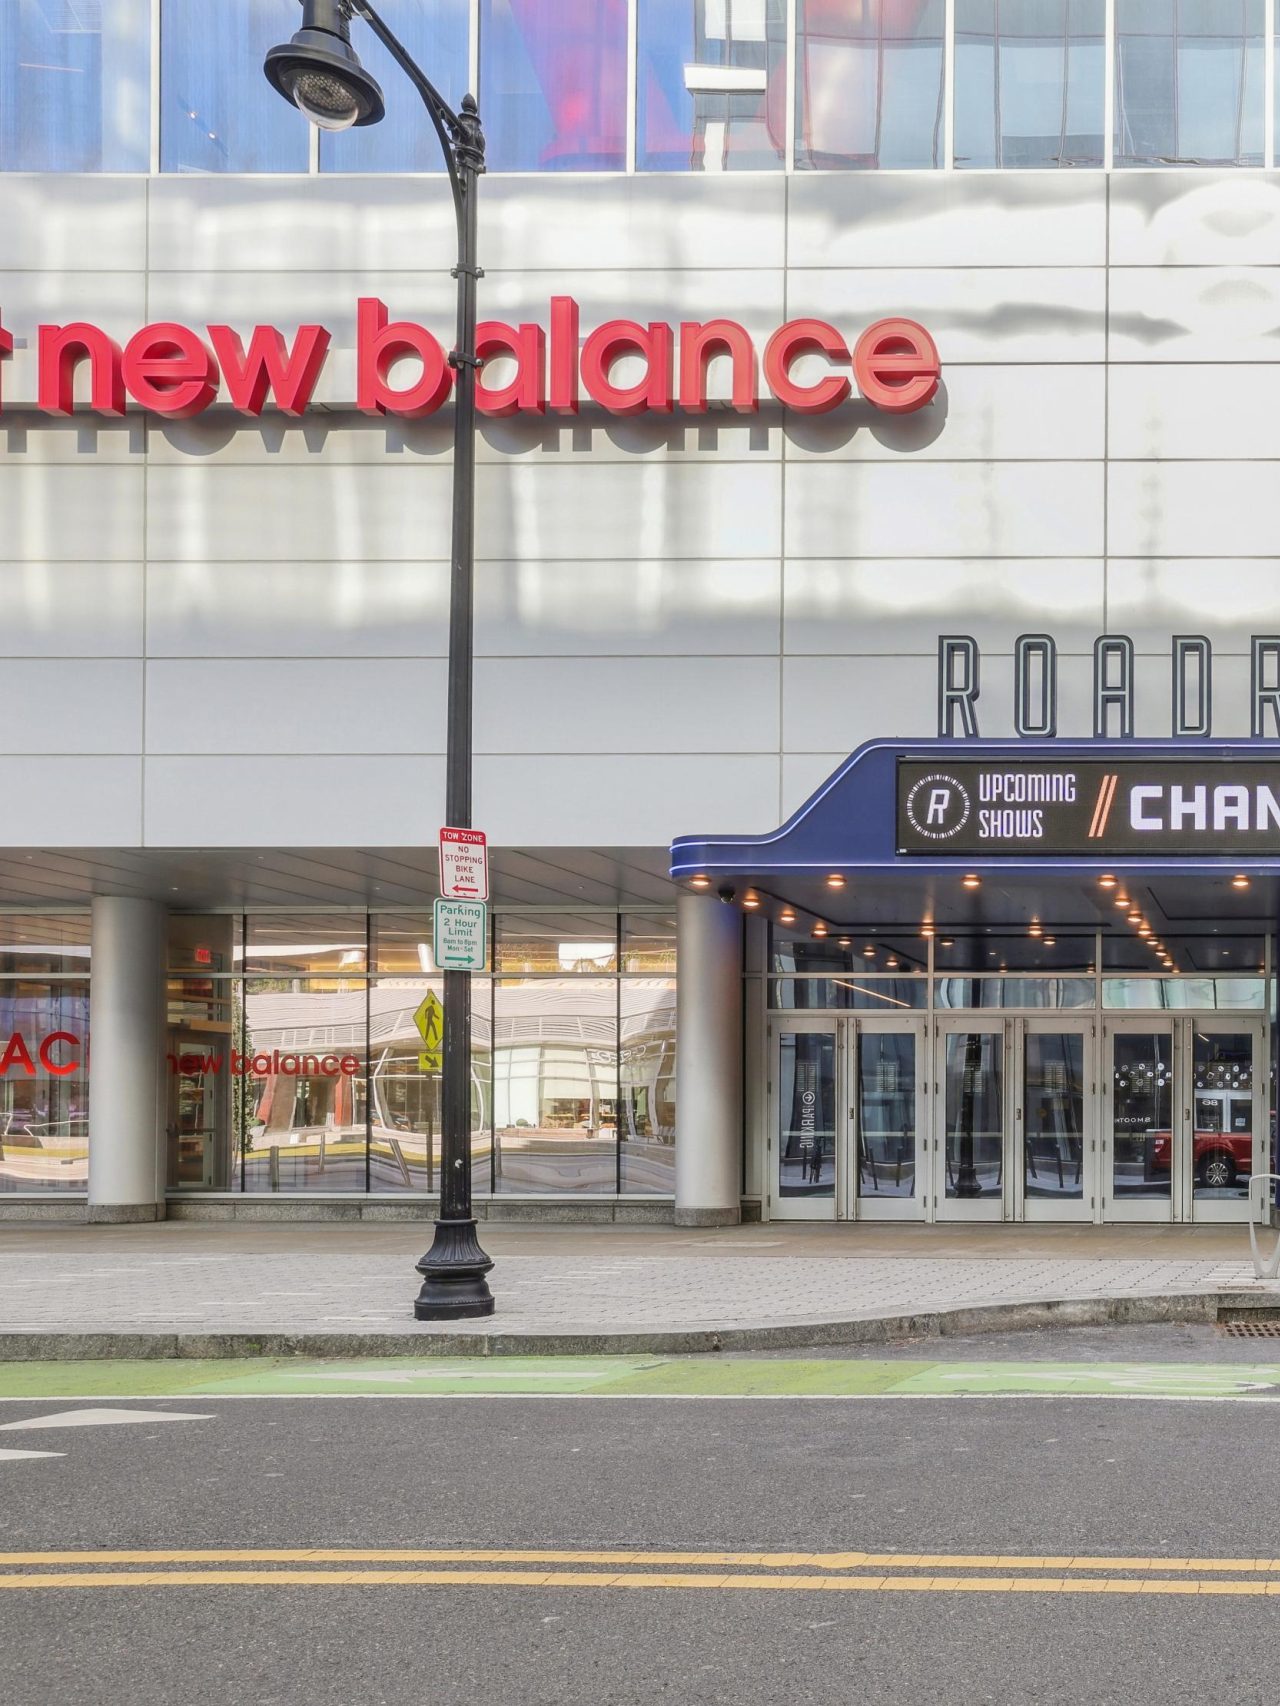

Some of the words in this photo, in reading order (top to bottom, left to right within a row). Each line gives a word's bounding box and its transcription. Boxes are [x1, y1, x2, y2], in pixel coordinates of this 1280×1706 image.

[37, 321, 331, 418] new
[357, 296, 941, 418] balance
[979, 774, 1075, 802] UPCOMING
[979, 810, 1043, 838] SHOWS
[443, 831, 458, 840] TOW
[462, 833, 483, 843] ZONE
[458, 845, 470, 853] NO
[445, 854, 483, 865] STOPPING
[455, 865, 474, 874] BIKE
[454, 875, 476, 884] LANE
[440, 904, 481, 919] Parking
[443, 918, 450, 926] 2
[455, 919, 477, 928] Hour
[448, 927, 473, 937] Limit
[0, 1030, 90, 1076] AC
[230, 1048, 361, 1076] balance
